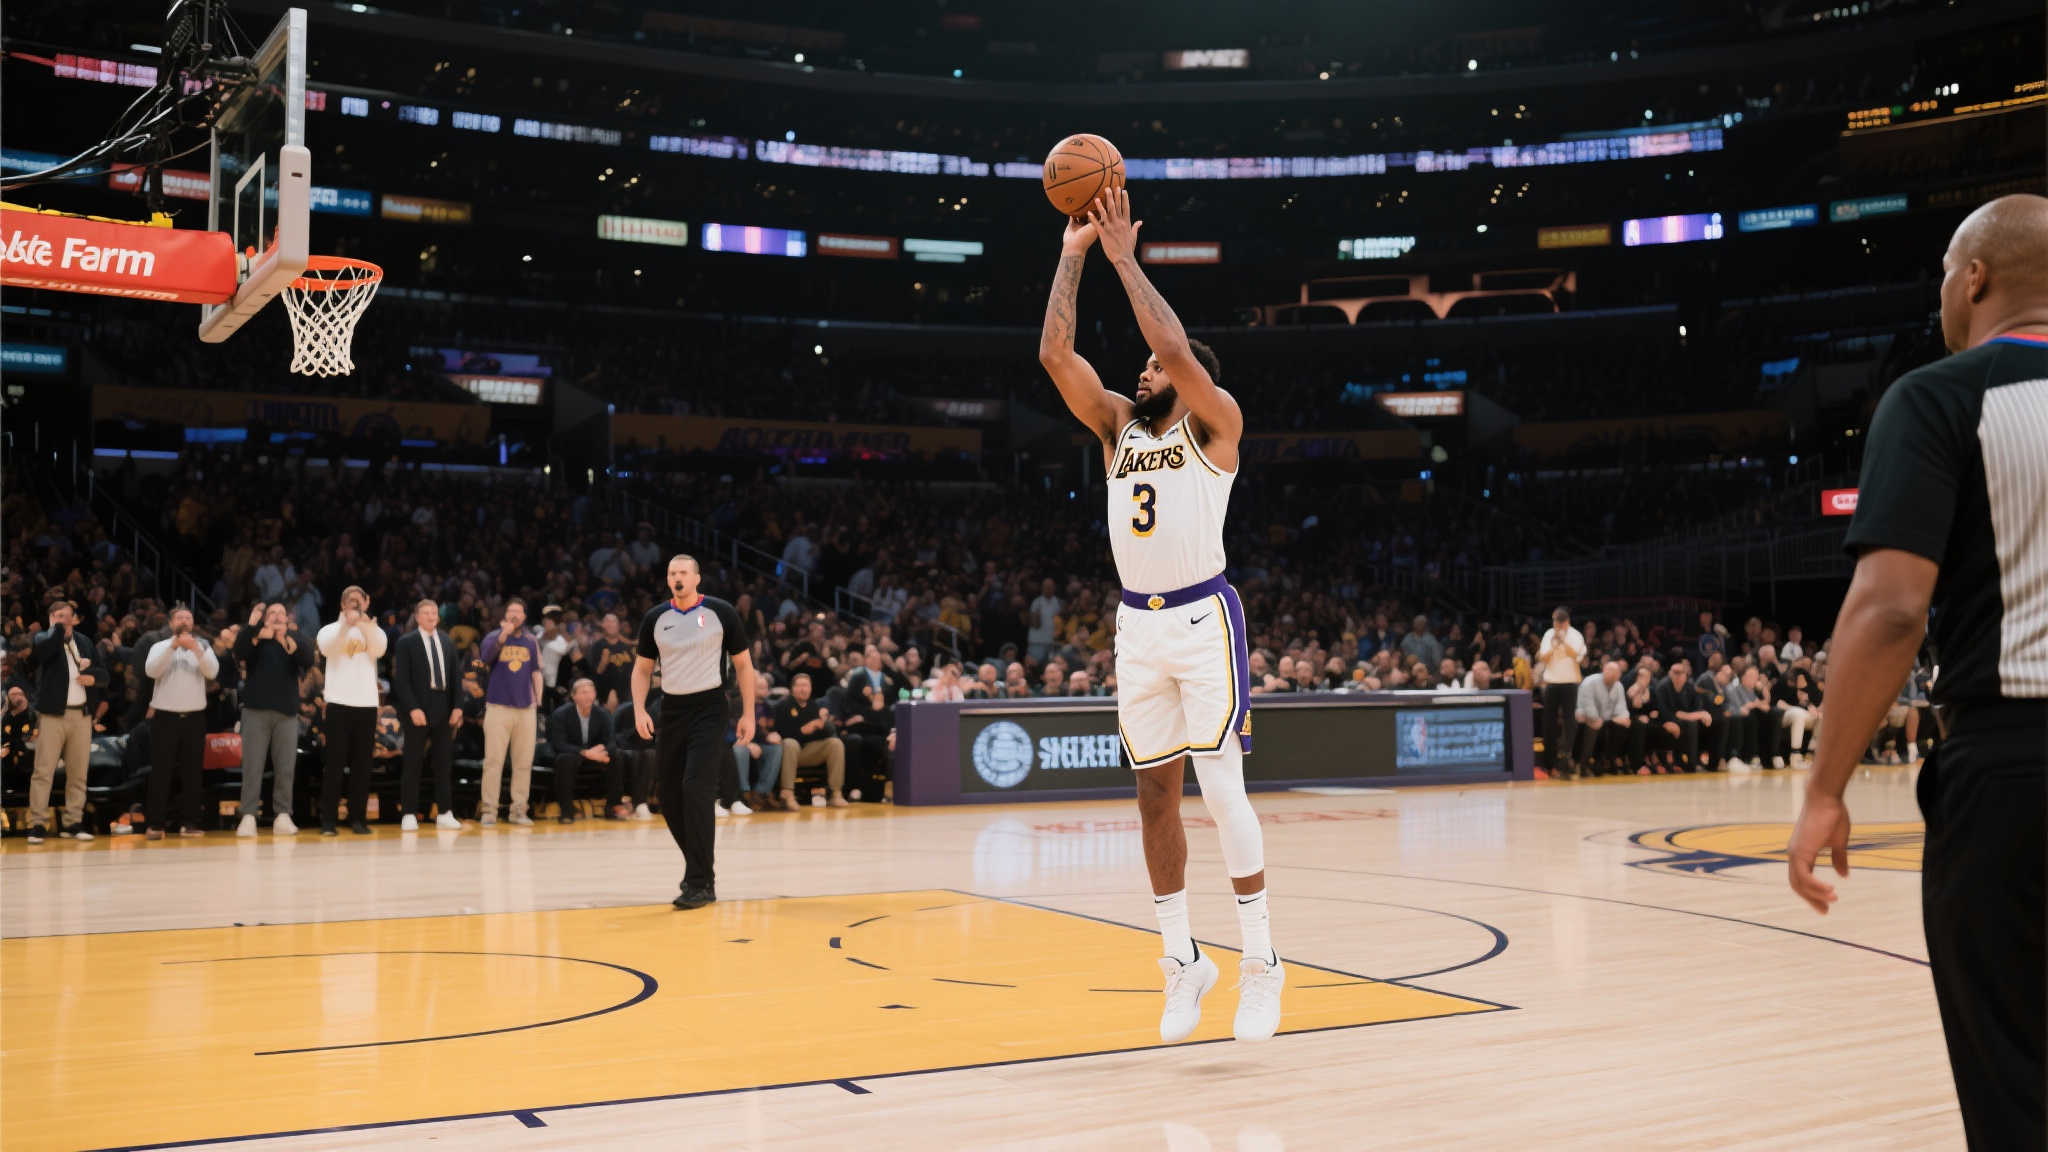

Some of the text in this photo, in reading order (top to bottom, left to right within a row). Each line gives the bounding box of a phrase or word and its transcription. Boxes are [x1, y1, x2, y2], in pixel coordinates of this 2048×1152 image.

[62, 238, 155, 277] Farm
[1115, 445, 1185, 479] LAKERS
[1132, 483, 1157, 537] 3
